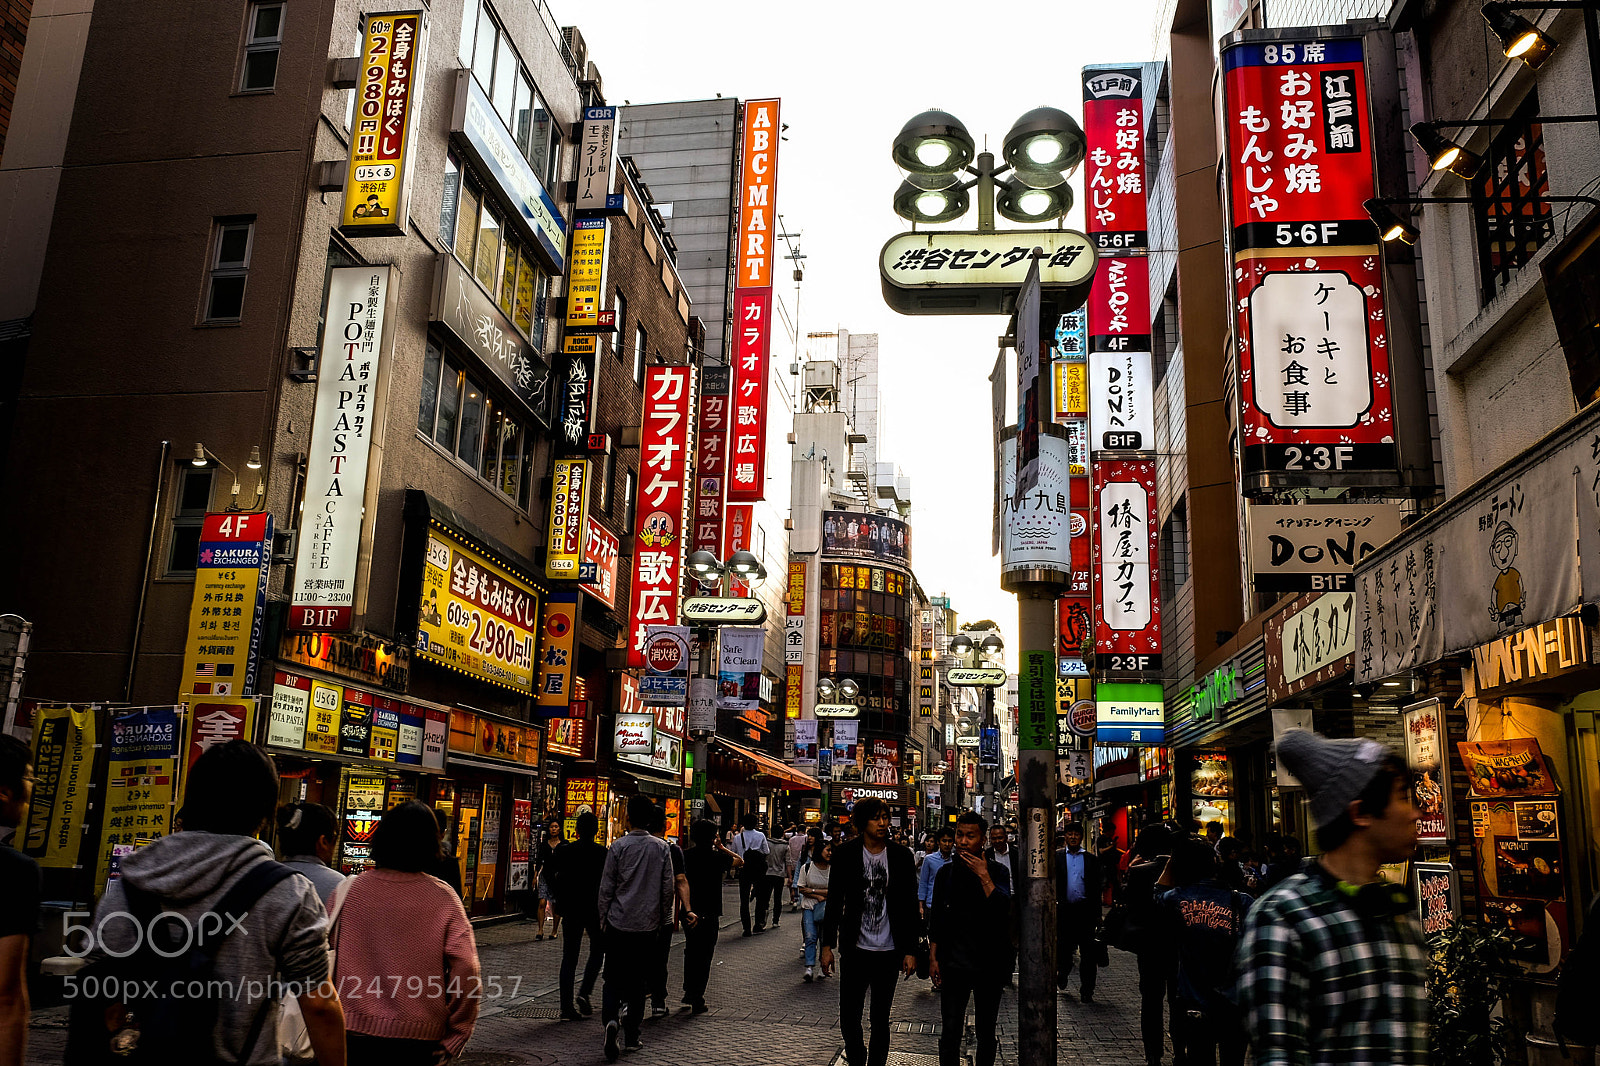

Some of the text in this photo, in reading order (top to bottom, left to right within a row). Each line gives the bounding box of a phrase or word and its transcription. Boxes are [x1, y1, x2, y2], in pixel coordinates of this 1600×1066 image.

[370, 20, 391, 34] 60分
[382, 23, 413, 155] 全身もみほぐし
[1091, 78, 1132, 93] 江戸前
[588, 109, 611, 118] CBR
[1325, 75, 1354, 149] 江戸前
[1280, 70, 1322, 193] お好み焼
[582, 125, 599, 199] モニタールーム
[1116, 108, 1142, 194] お好み焼
[1239, 105, 1278, 218] もんじゃ
[359, 168, 391, 178] りらくる
[360, 182, 387, 192] 渋谷店
[1090, 147, 1116, 226] もんじゃ
[892, 245, 1085, 271] 渋谷センター街
[361, 274, 380, 352] 自家製生麺専門
[599, 315, 613, 323] 4F
[1061, 315, 1079, 353] 麻雀
[1108, 338, 1129, 350] 4F
[1313, 282, 1341, 386] ケーキと
[1280, 334, 1312, 417] お食事
[353, 361, 371, 438] ポタ パスタ カフェ
[735, 302, 762, 484] カラオケ 歌広場
[1108, 367, 1125, 427] DONA
[320, 302, 363, 570] POTA PASTA CAFFE
[590, 436, 603, 447] 3F
[644, 367, 684, 508] カラオケ
[703, 396, 723, 470] カラオケ
[1109, 435, 1135, 447] B1F
[566, 465, 582, 551] 全身もみほぐし
[1004, 490, 1067, 515] 九十九島
[219, 516, 249, 538] 4F
[215, 549, 259, 557] SAKURA
[311, 514, 321, 570] STREET
[1107, 499, 1141, 613] 椿屋カフェ
[304, 579, 345, 590] 営業時間
[580, 566, 595, 578] 2F
[1311, 575, 1347, 590] B1F
[452, 558, 533, 627] 全身もみほぐし
[790, 574, 804, 613] 串焼き
[1423, 540, 1436, 631] 唐揚げ
[244, 538, 271, 695] MONEY EXCHANGE
[302, 609, 338, 627] B1F
[447, 601, 470, 628] 60分
[687, 603, 759, 613] 渋谷センター街
[1390, 560, 1405, 669] チャーハン
[651, 648, 678, 662] 消火栓
[723, 645, 743, 654] Safe
[724, 656, 757, 665] & Clean
[285, 674, 298, 686] B1F
[543, 645, 567, 694] 松屋
[950, 672, 1004, 680] 渋谷センター街
[316, 691, 335, 706] りらくる
[1028, 654, 1046, 746] 客引きは犯罪です
[1110, 707, 1160, 718] FamilyMart
[616, 730, 643, 738] Miami
[1130, 730, 1141, 741] 酒
[567, 791, 594, 800] 歌広場
[568, 781, 595, 790] カラオケ
[355, 821, 371, 833] 3F
